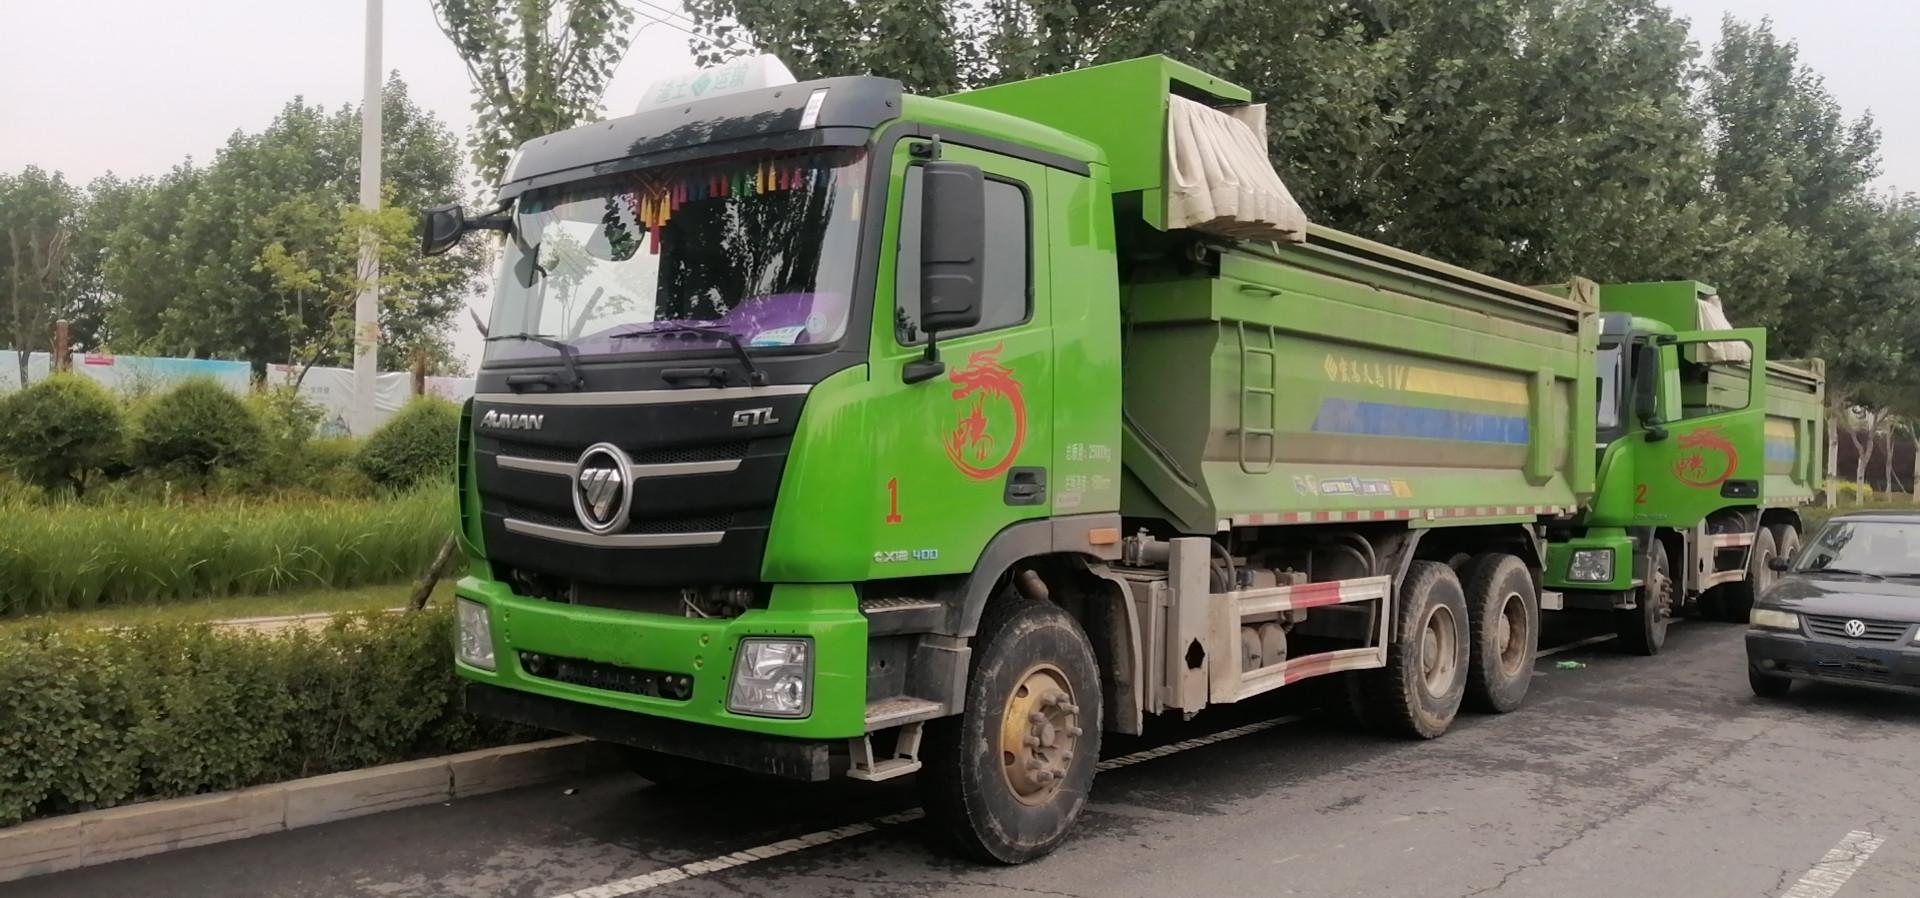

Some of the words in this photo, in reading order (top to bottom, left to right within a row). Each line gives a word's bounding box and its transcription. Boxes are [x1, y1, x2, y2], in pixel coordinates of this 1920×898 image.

[479, 409, 544, 430] AUMAN
[732, 406, 779, 428] GTL
[886, 477, 902, 524] 1
[1635, 484, 1649, 504] 2
[911, 548, 938, 560] 400
